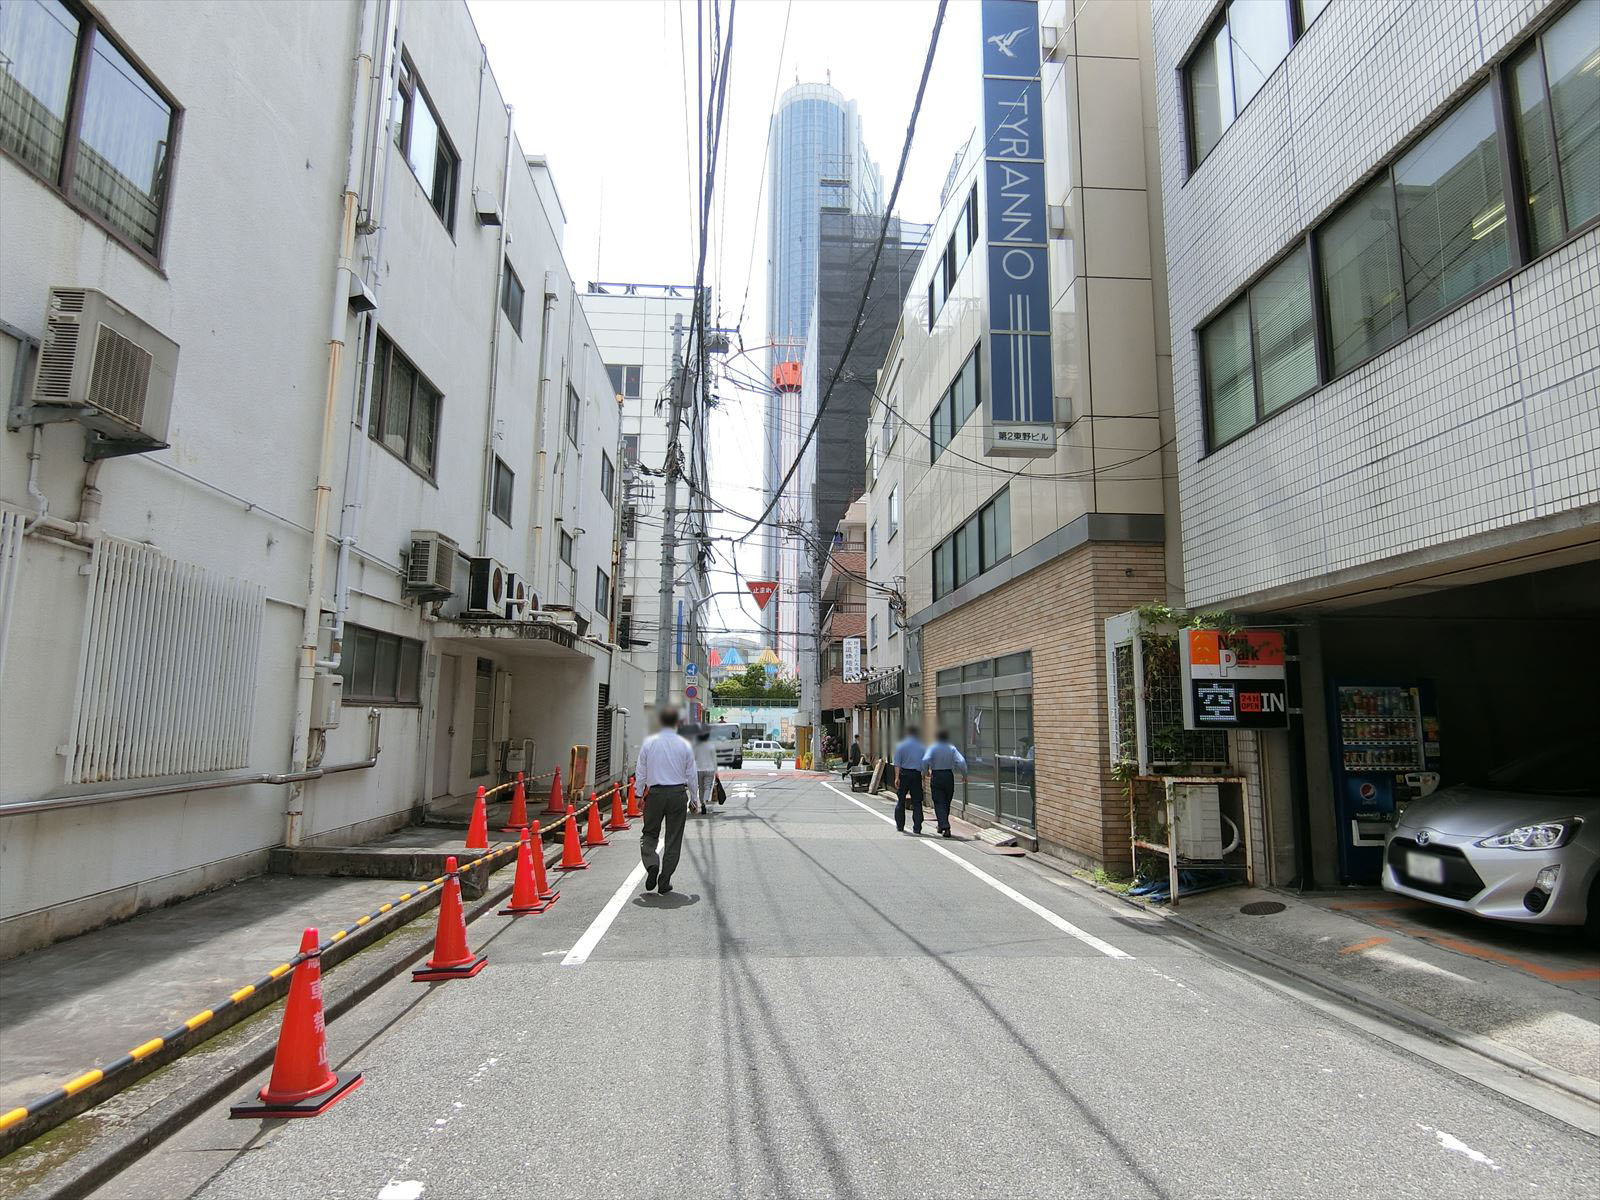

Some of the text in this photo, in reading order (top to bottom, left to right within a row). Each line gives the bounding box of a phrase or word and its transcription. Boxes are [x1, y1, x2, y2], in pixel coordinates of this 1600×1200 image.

[998, 94, 1035, 280] TYRANNO
[998, 431, 1049, 442] 第2東野ビル
[752, 586, 772, 594] 止まれ
[1198, 683, 1236, 720] 空
[1241, 694, 1259, 702] 24H
[1260, 692, 1285, 712] IN
[1241, 702, 1259, 710] OPEN
